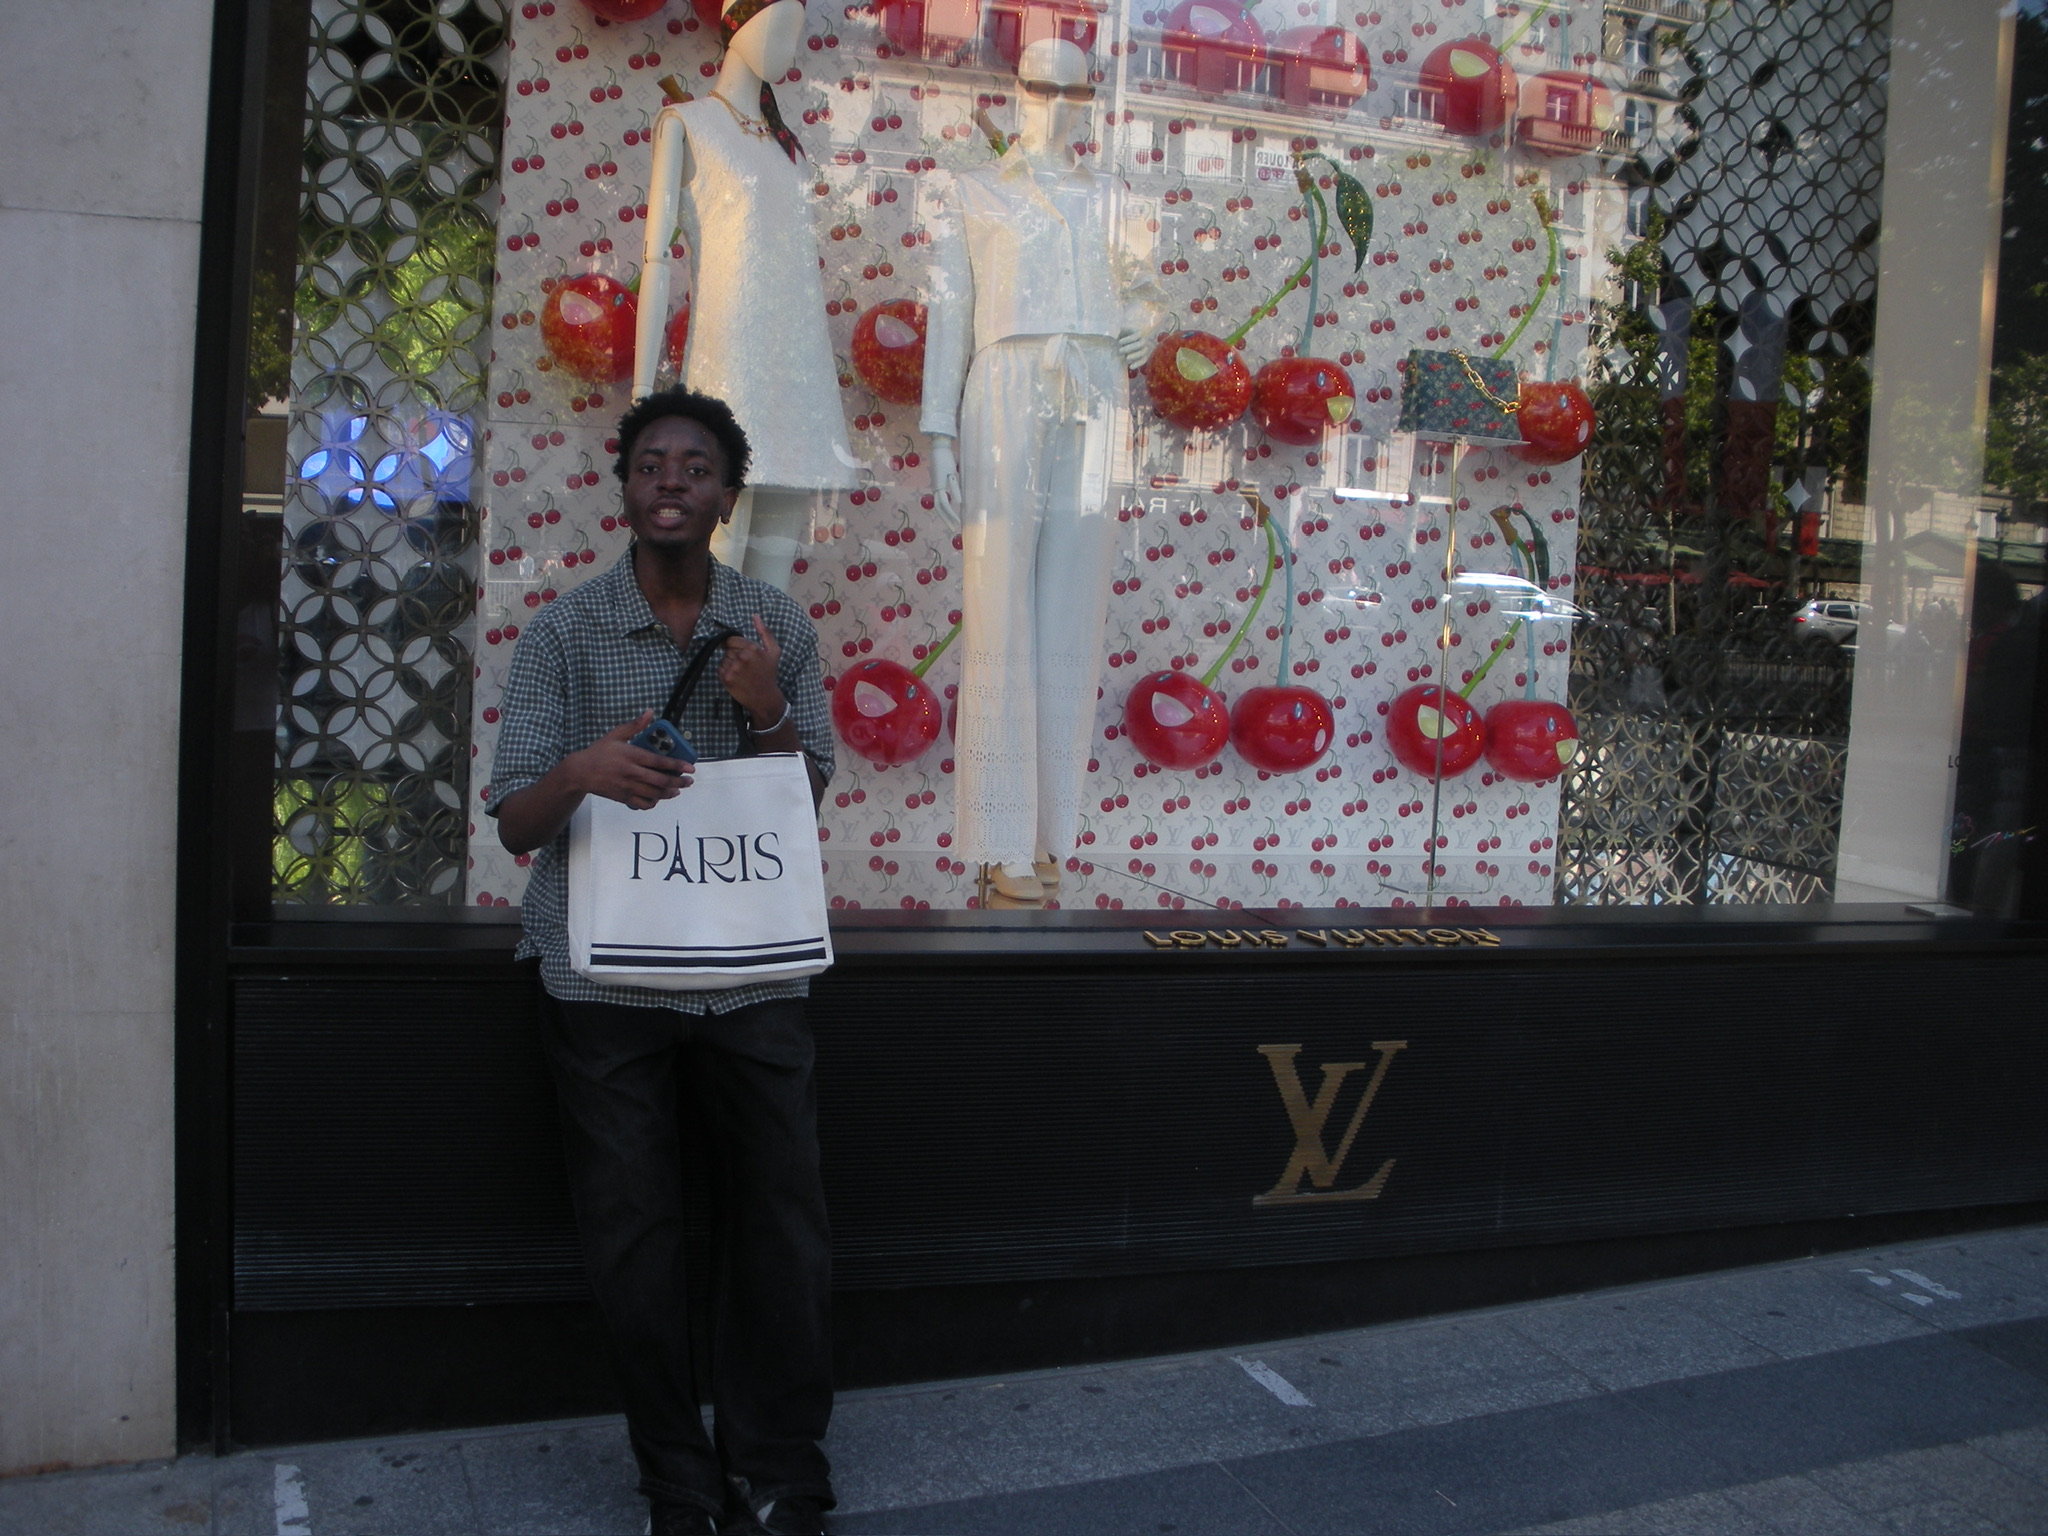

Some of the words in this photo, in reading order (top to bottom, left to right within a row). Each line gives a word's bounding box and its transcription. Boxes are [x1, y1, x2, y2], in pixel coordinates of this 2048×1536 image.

[629, 819, 784, 884] PARIS
[1143, 929, 1288, 946] LOUIS
[1297, 927, 1501, 946] VUITTON
